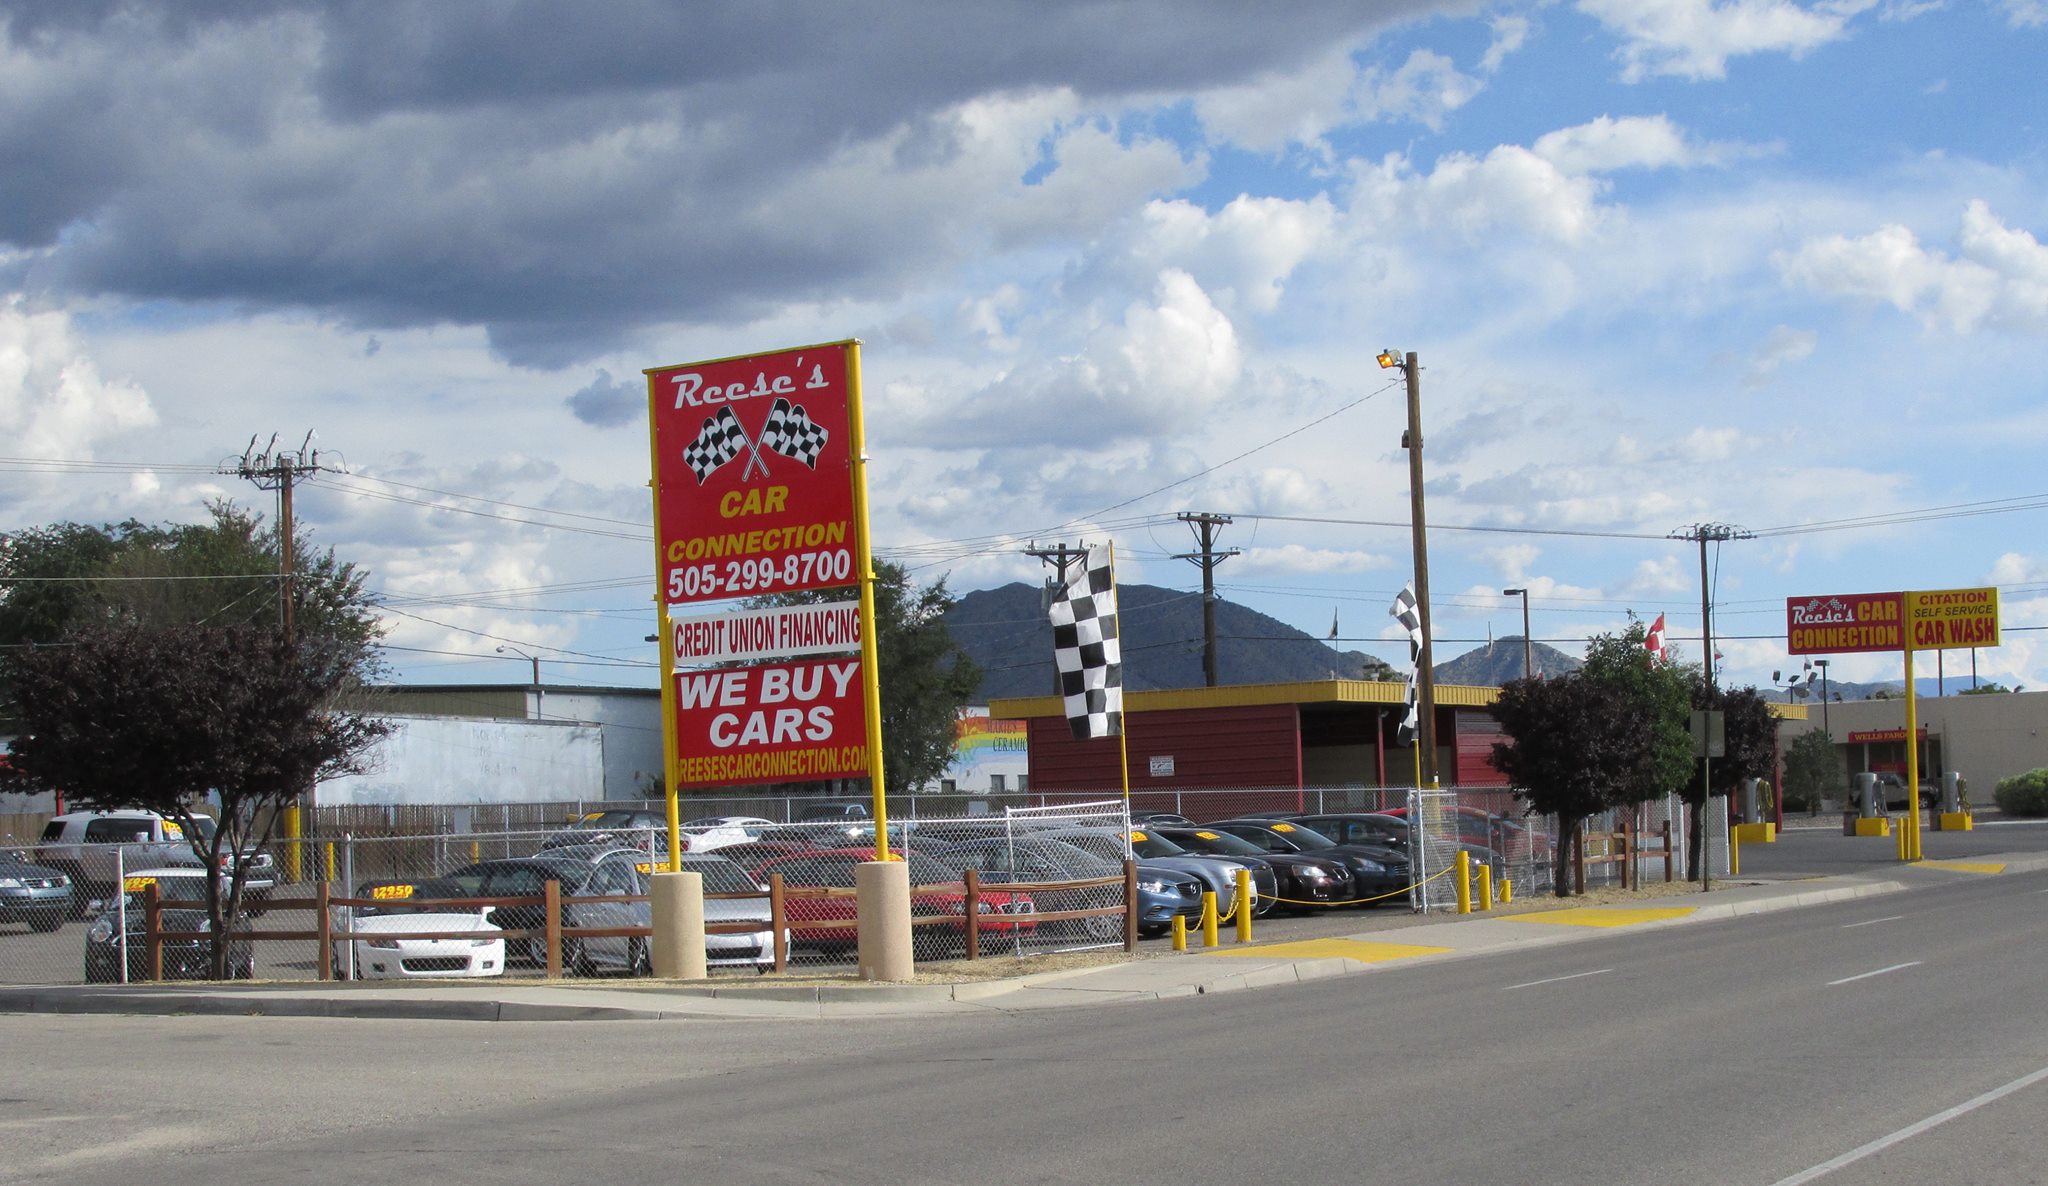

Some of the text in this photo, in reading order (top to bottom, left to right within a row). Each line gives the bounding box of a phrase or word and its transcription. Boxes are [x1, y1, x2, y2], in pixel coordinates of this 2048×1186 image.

[670, 357, 829, 409] Reese's
[720, 485, 789, 518] CAR
[668, 521, 847, 562] CONNECTION
[669, 549, 851, 598] 505-299-8700
[1791, 600, 1898, 625] Reese's CAR
[1914, 604, 1993, 618] SELF SERVICE
[1919, 592, 1987, 606] CITATION
[675, 607, 861, 658] CREDIT UNION FINANCING
[1791, 625, 1898, 649] CONNECTION
[1914, 617, 1995, 645] CAR WASH
[680, 662, 860, 710] WE BUY
[709, 706, 835, 748] CARS
[1854, 732, 1883, 741] WELLS
[679, 748, 869, 782] REESESCARCONNECTION.COM
